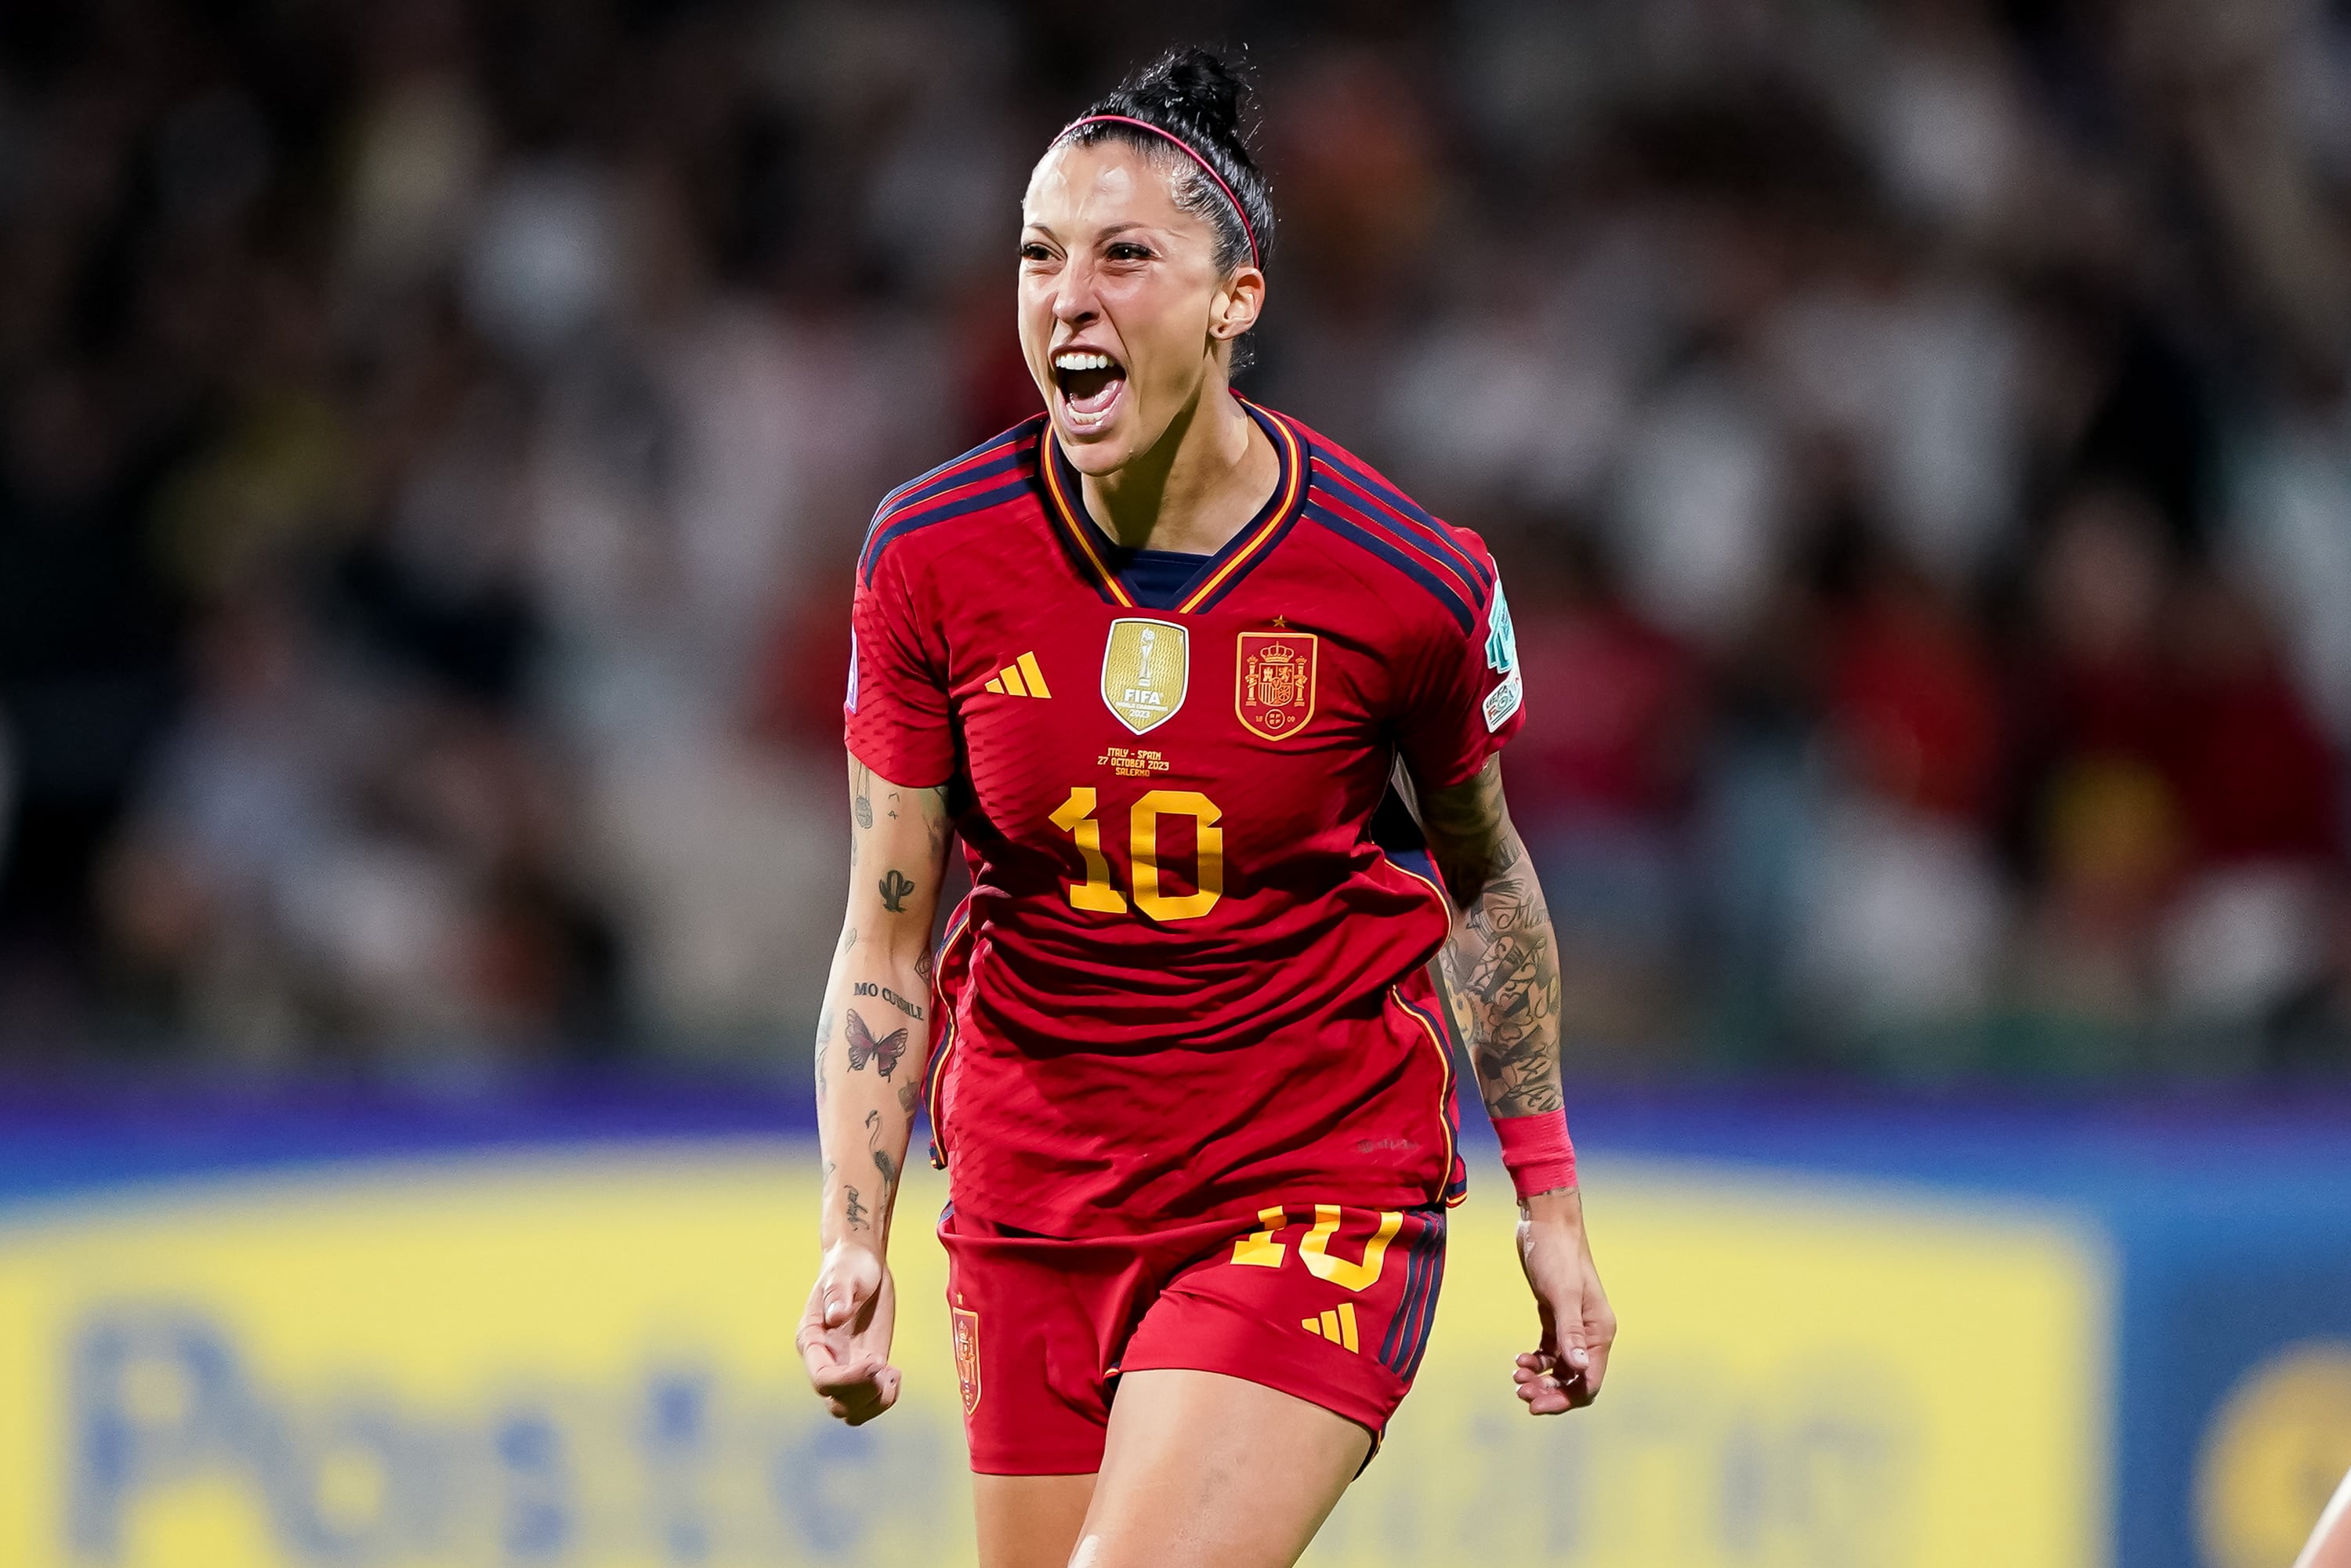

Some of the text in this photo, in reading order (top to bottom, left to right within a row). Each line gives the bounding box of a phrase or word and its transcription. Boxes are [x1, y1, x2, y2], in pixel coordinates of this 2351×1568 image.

[1124, 689, 1161, 704] FIFA
[1107, 747, 1129, 758] ITALY
[1137, 750, 1161, 761] SPAIN
[1097, 756, 1169, 771] 27 OCTOBER 2023
[1115, 767, 1150, 777] SALERNO
[1049, 787, 1223, 922] 10
[854, 983, 878, 997] MO
